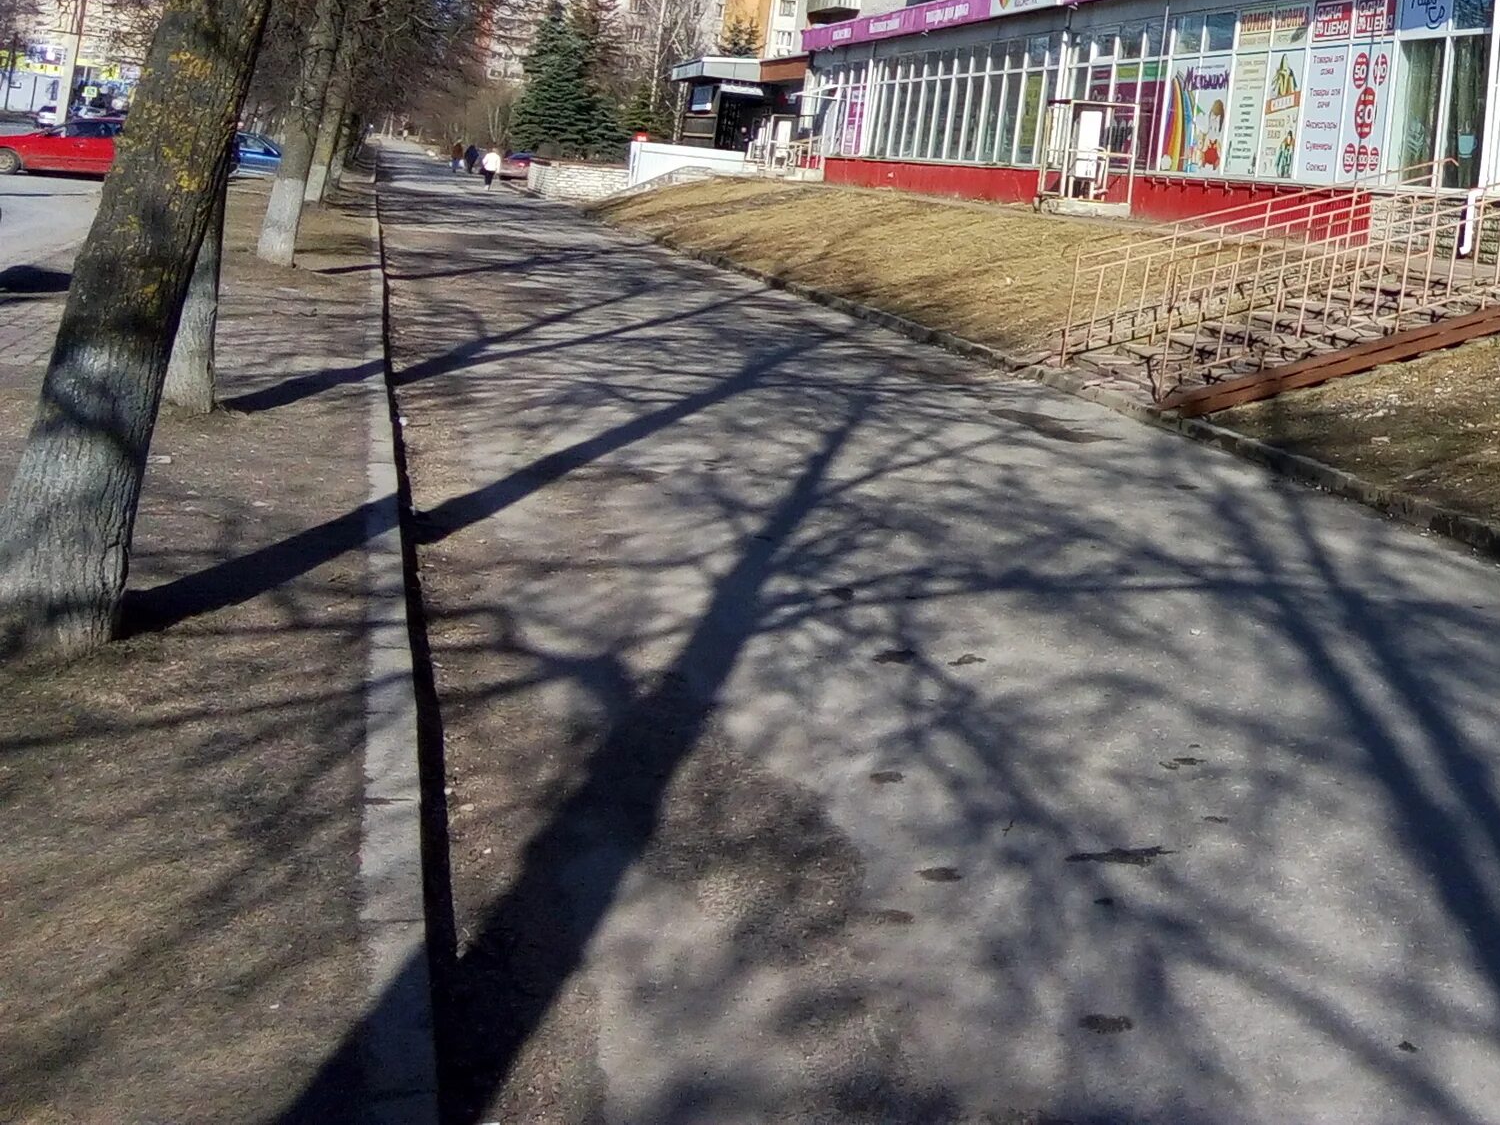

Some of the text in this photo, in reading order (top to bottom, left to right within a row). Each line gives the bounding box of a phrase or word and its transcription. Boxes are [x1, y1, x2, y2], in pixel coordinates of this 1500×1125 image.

[1317, 4, 1343, 21] ОДНА
[1324, 19, 1349, 36] ЦЕНА
[1354, 64, 1367, 79] 50
[1356, 104, 1373, 124] 30
